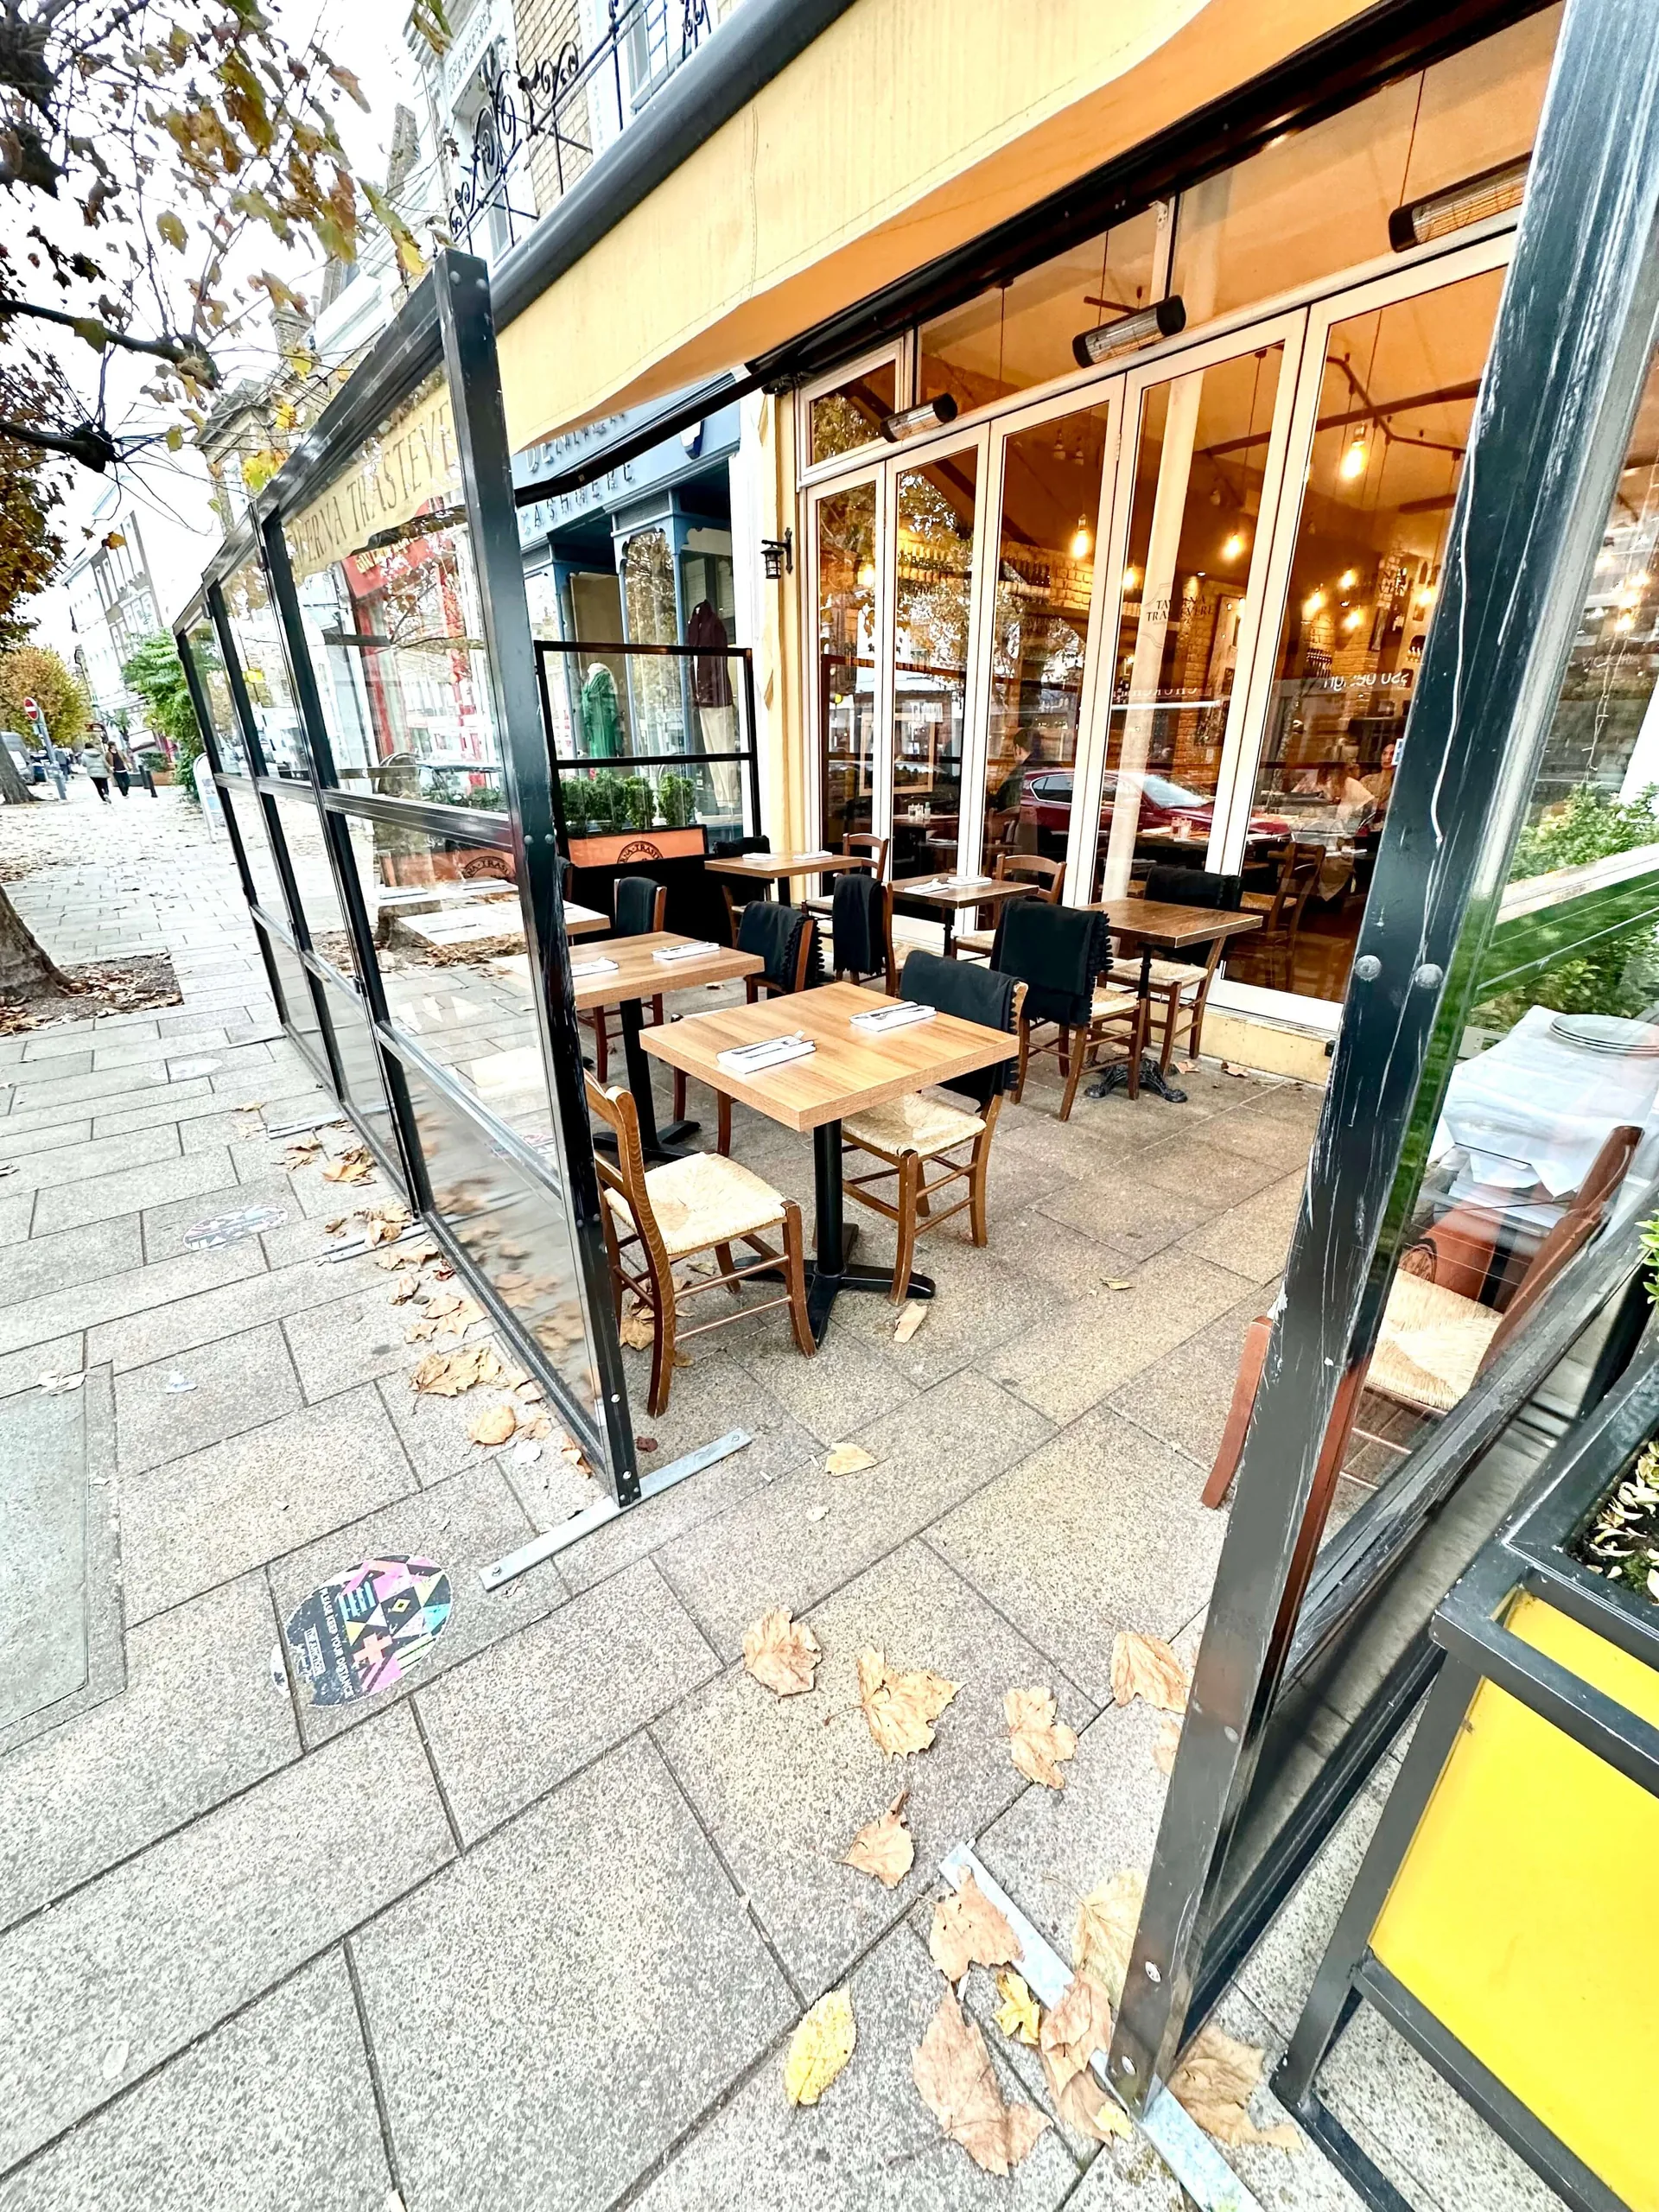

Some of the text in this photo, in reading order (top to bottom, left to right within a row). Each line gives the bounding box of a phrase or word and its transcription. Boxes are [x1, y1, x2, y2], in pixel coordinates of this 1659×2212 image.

[286, 400, 456, 567] VERNA TRASTEVE
[319, 1587, 354, 1700] PLEASE KEEP YOUR DISTANCE
